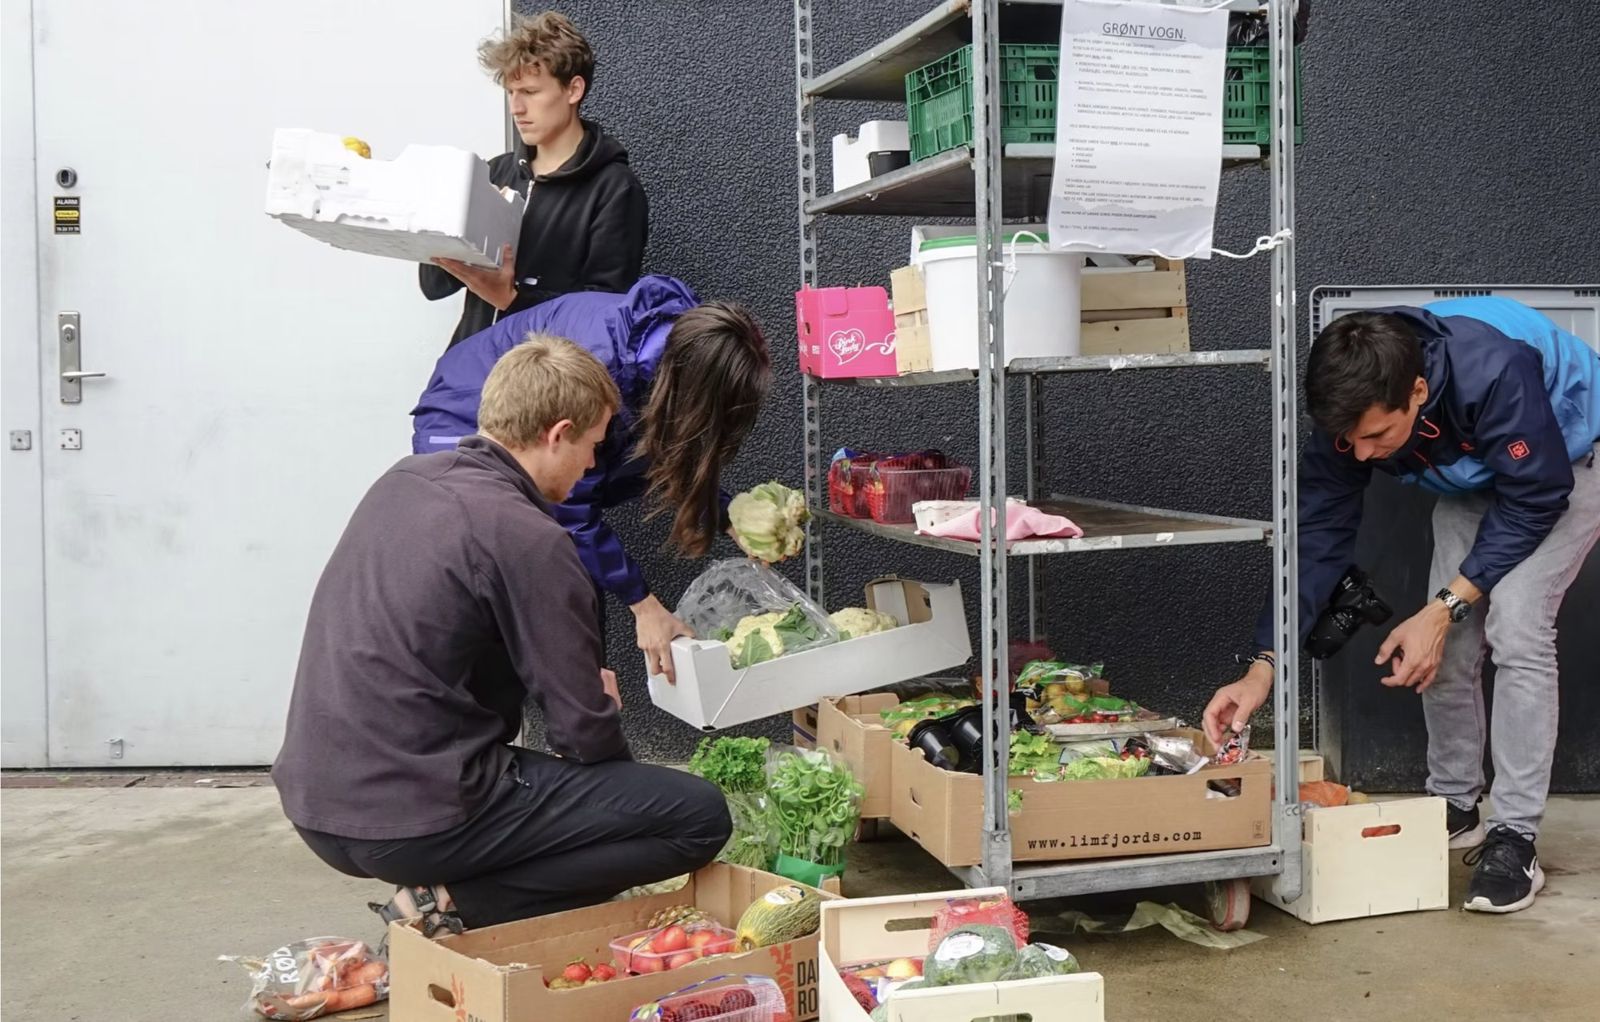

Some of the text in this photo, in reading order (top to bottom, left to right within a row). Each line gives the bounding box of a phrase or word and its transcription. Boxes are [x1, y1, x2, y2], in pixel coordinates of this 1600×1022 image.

[1102, 22, 1187, 39] GRØNT VOGN.
[832, 335, 856, 350] Pink
[1027, 830, 1202, 850] www.limfjords.com
